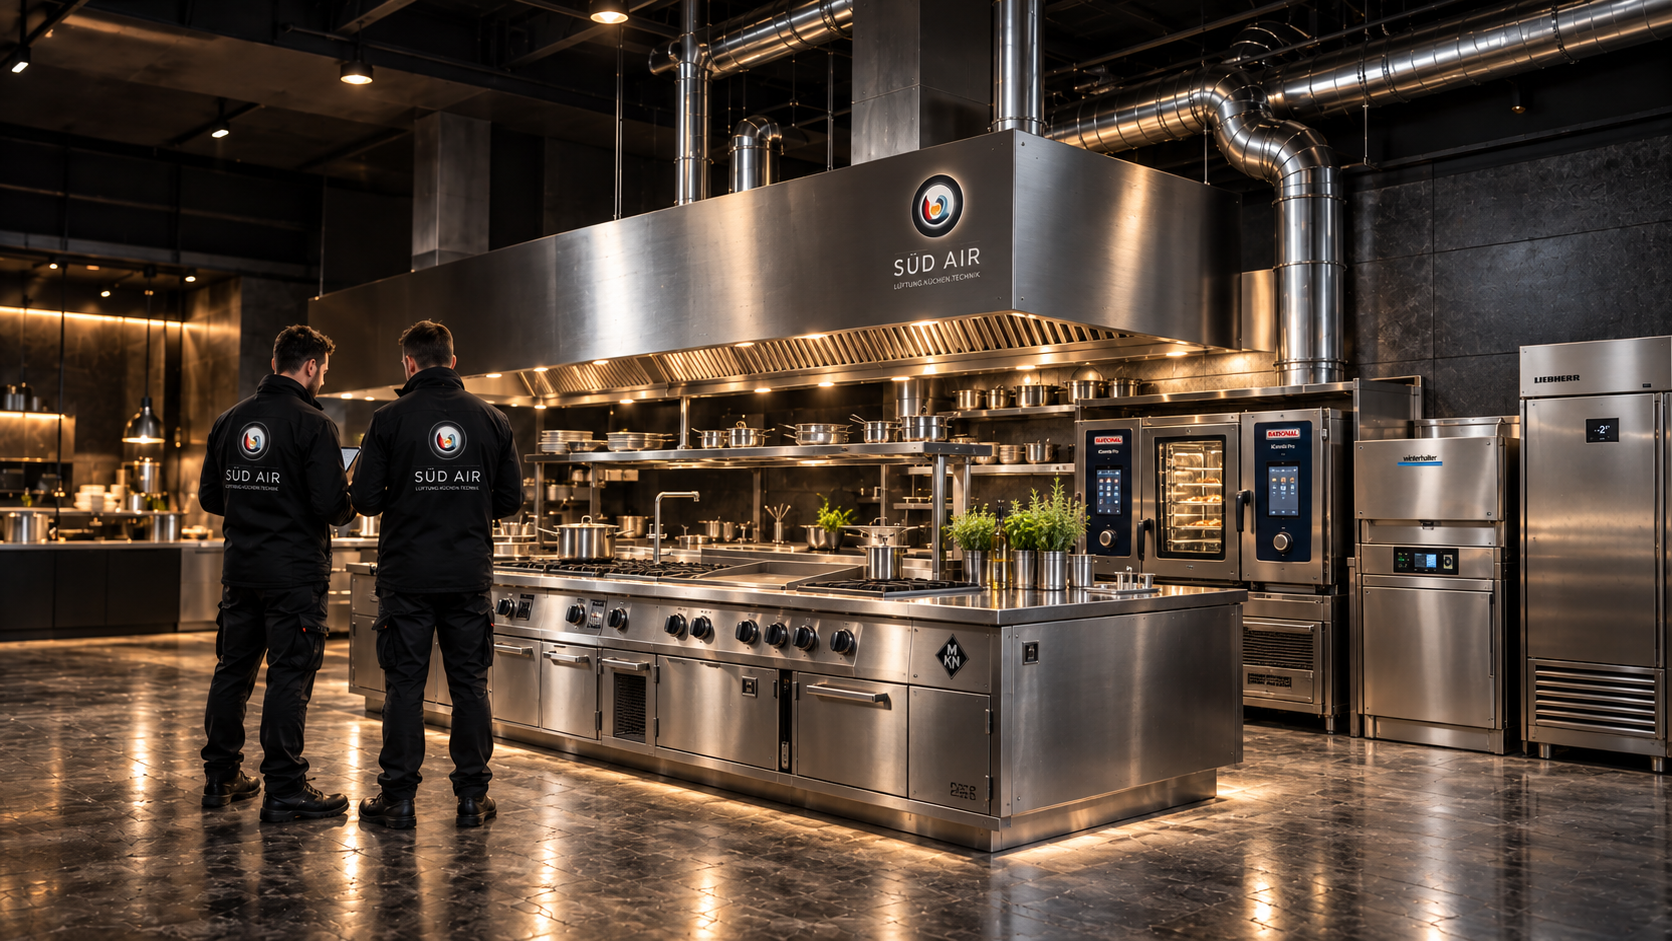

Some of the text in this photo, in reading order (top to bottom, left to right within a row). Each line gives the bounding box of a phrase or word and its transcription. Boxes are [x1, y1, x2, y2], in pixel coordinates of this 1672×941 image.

[893, 247, 980, 277] SÜD AIR
[1534, 374, 1580, 384] LIEBHERR
[225, 466, 281, 484] SÜD AIR
[414, 467, 481, 483] SÜD AIR
